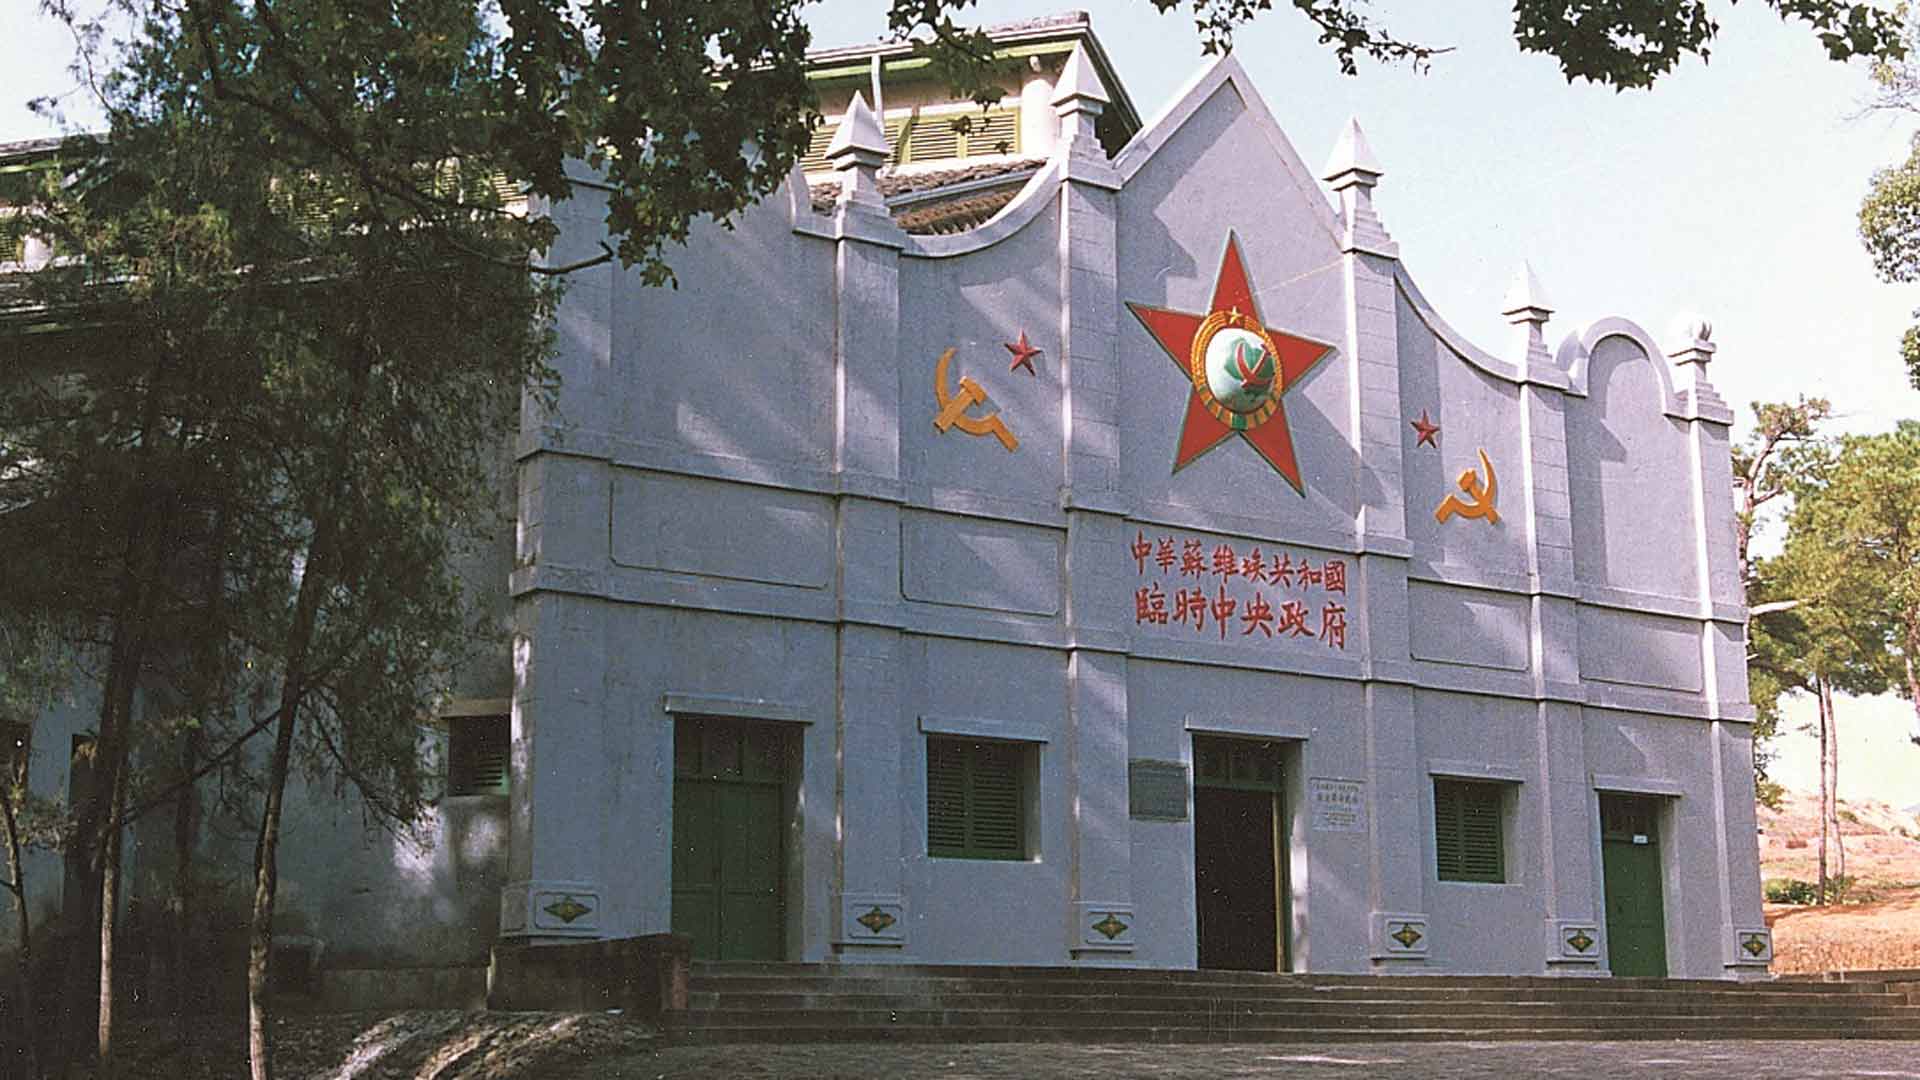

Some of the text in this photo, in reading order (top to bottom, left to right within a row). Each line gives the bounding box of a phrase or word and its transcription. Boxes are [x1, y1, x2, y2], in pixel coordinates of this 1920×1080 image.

[1131, 530, 1346, 595] 中華蘇維埃共和國
[1135, 582, 1347, 649] 臨時中央政府
